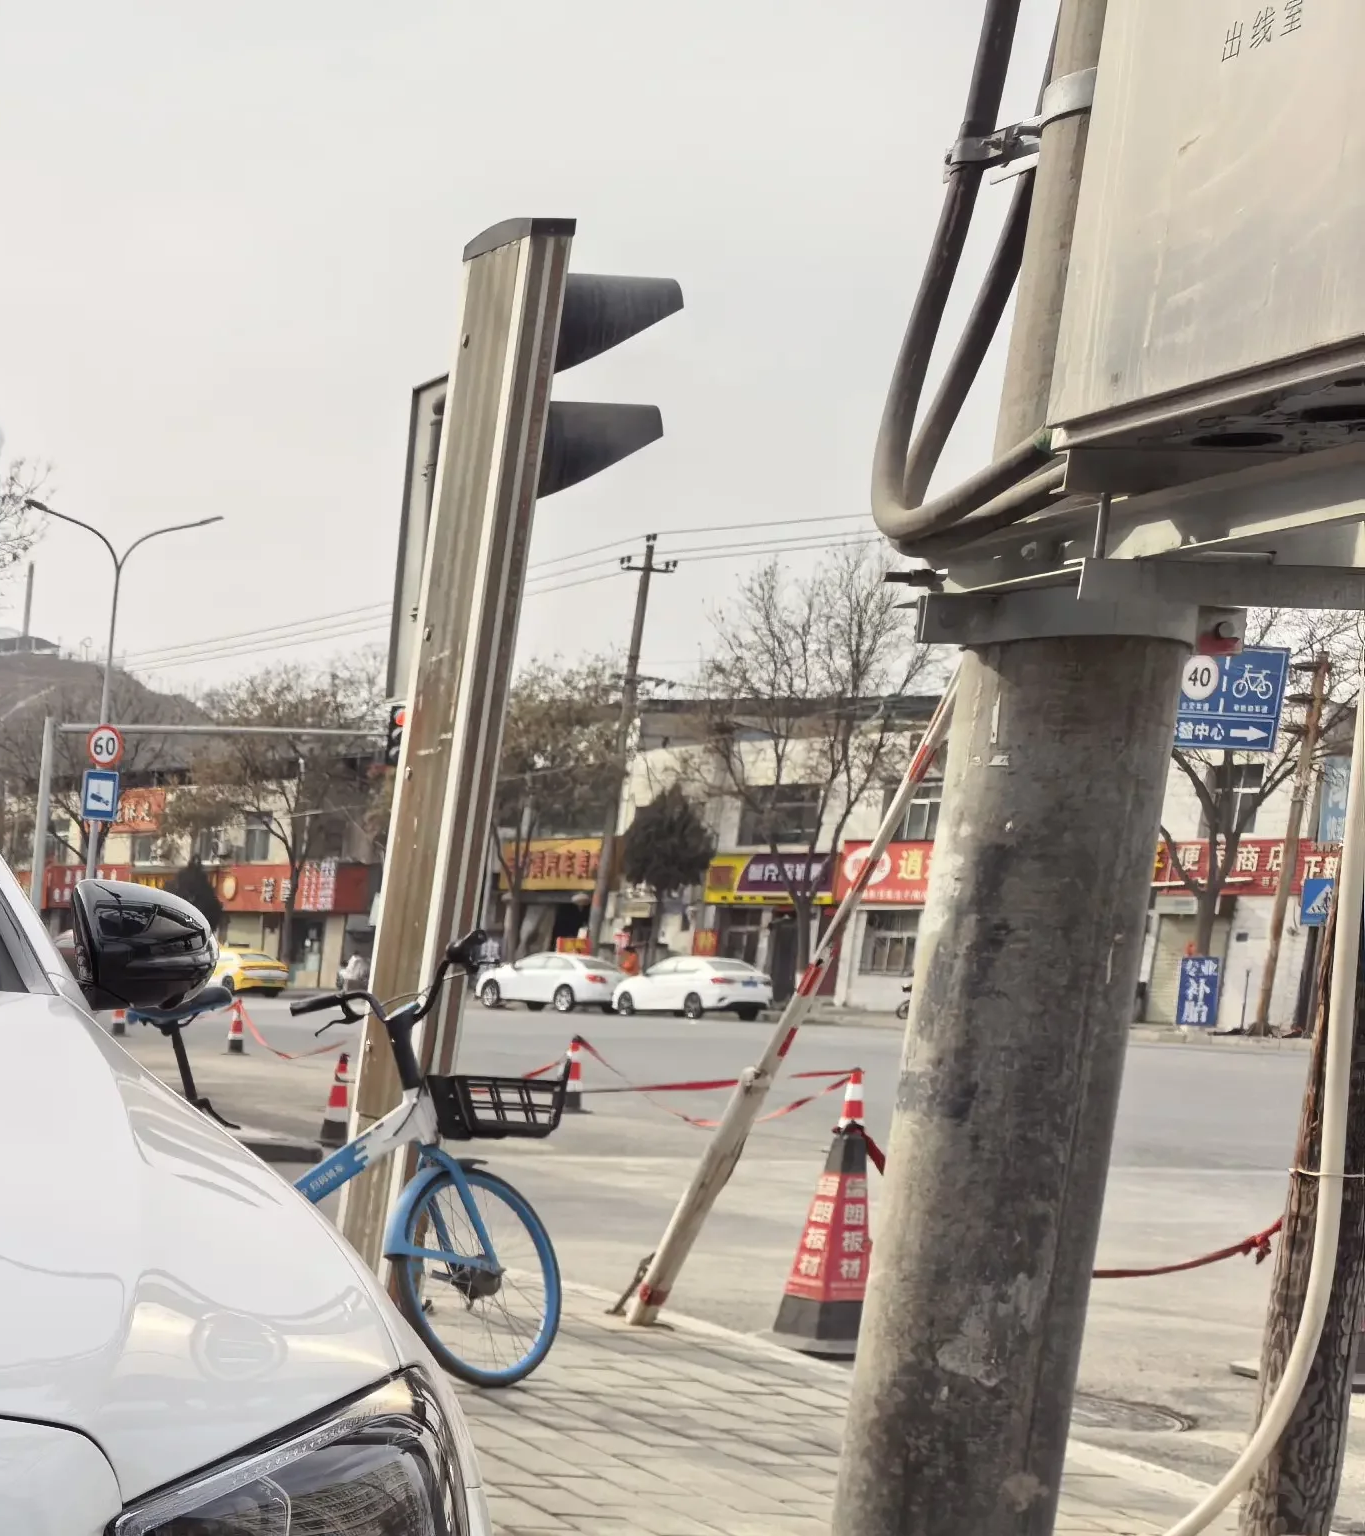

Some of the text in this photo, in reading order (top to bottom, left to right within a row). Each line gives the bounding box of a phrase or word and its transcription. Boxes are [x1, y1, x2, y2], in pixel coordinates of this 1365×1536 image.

[1221, 0, 1303, 62] 出线室
[1188, 667, 1211, 687] 40
[93, 736, 116, 756] 60
